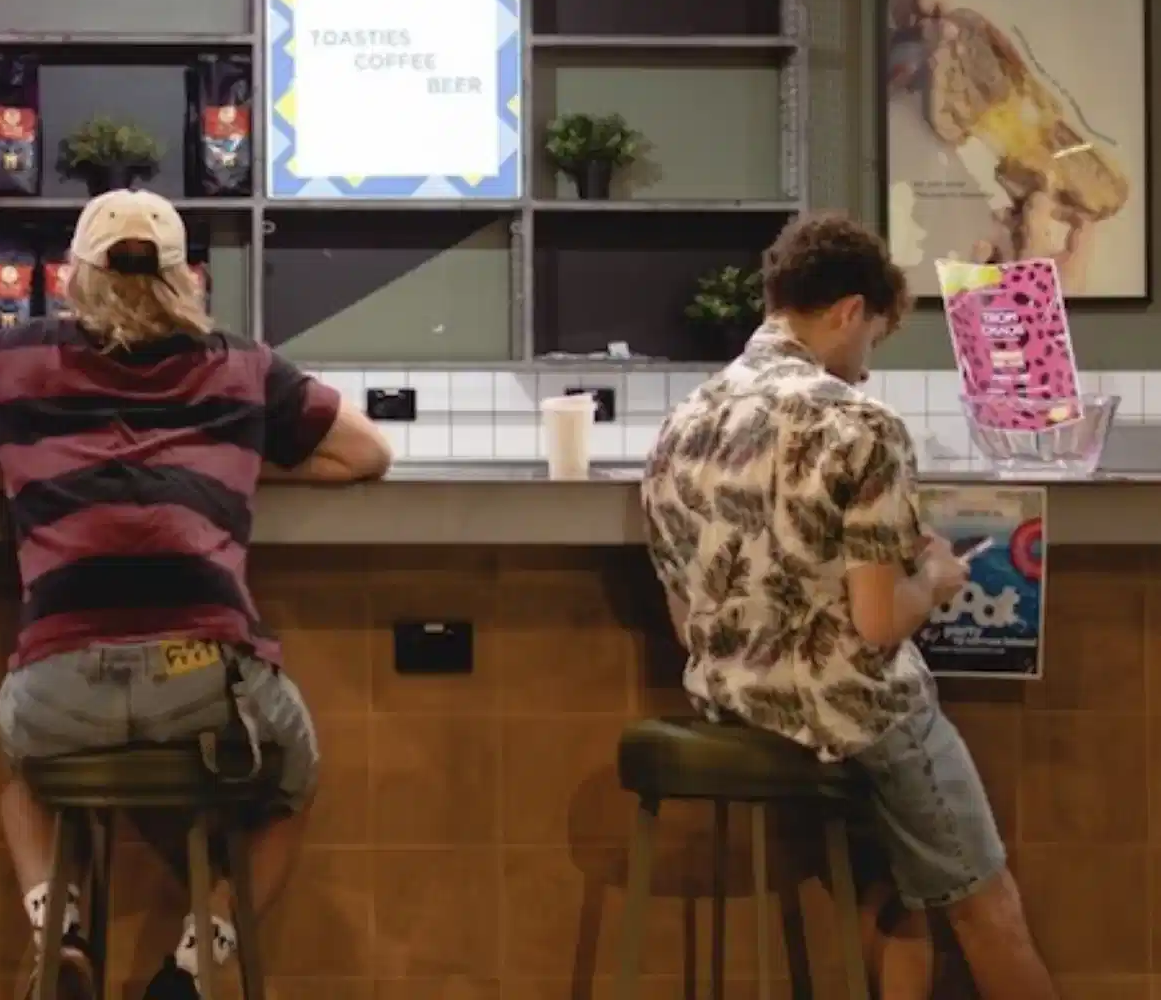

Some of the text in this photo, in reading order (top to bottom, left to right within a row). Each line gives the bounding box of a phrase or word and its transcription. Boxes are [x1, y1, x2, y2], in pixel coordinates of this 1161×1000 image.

[310, 29, 411, 47] TOASTIES
[353, 53, 436, 71] COFFEE
[426, 76, 483, 95] BEER
